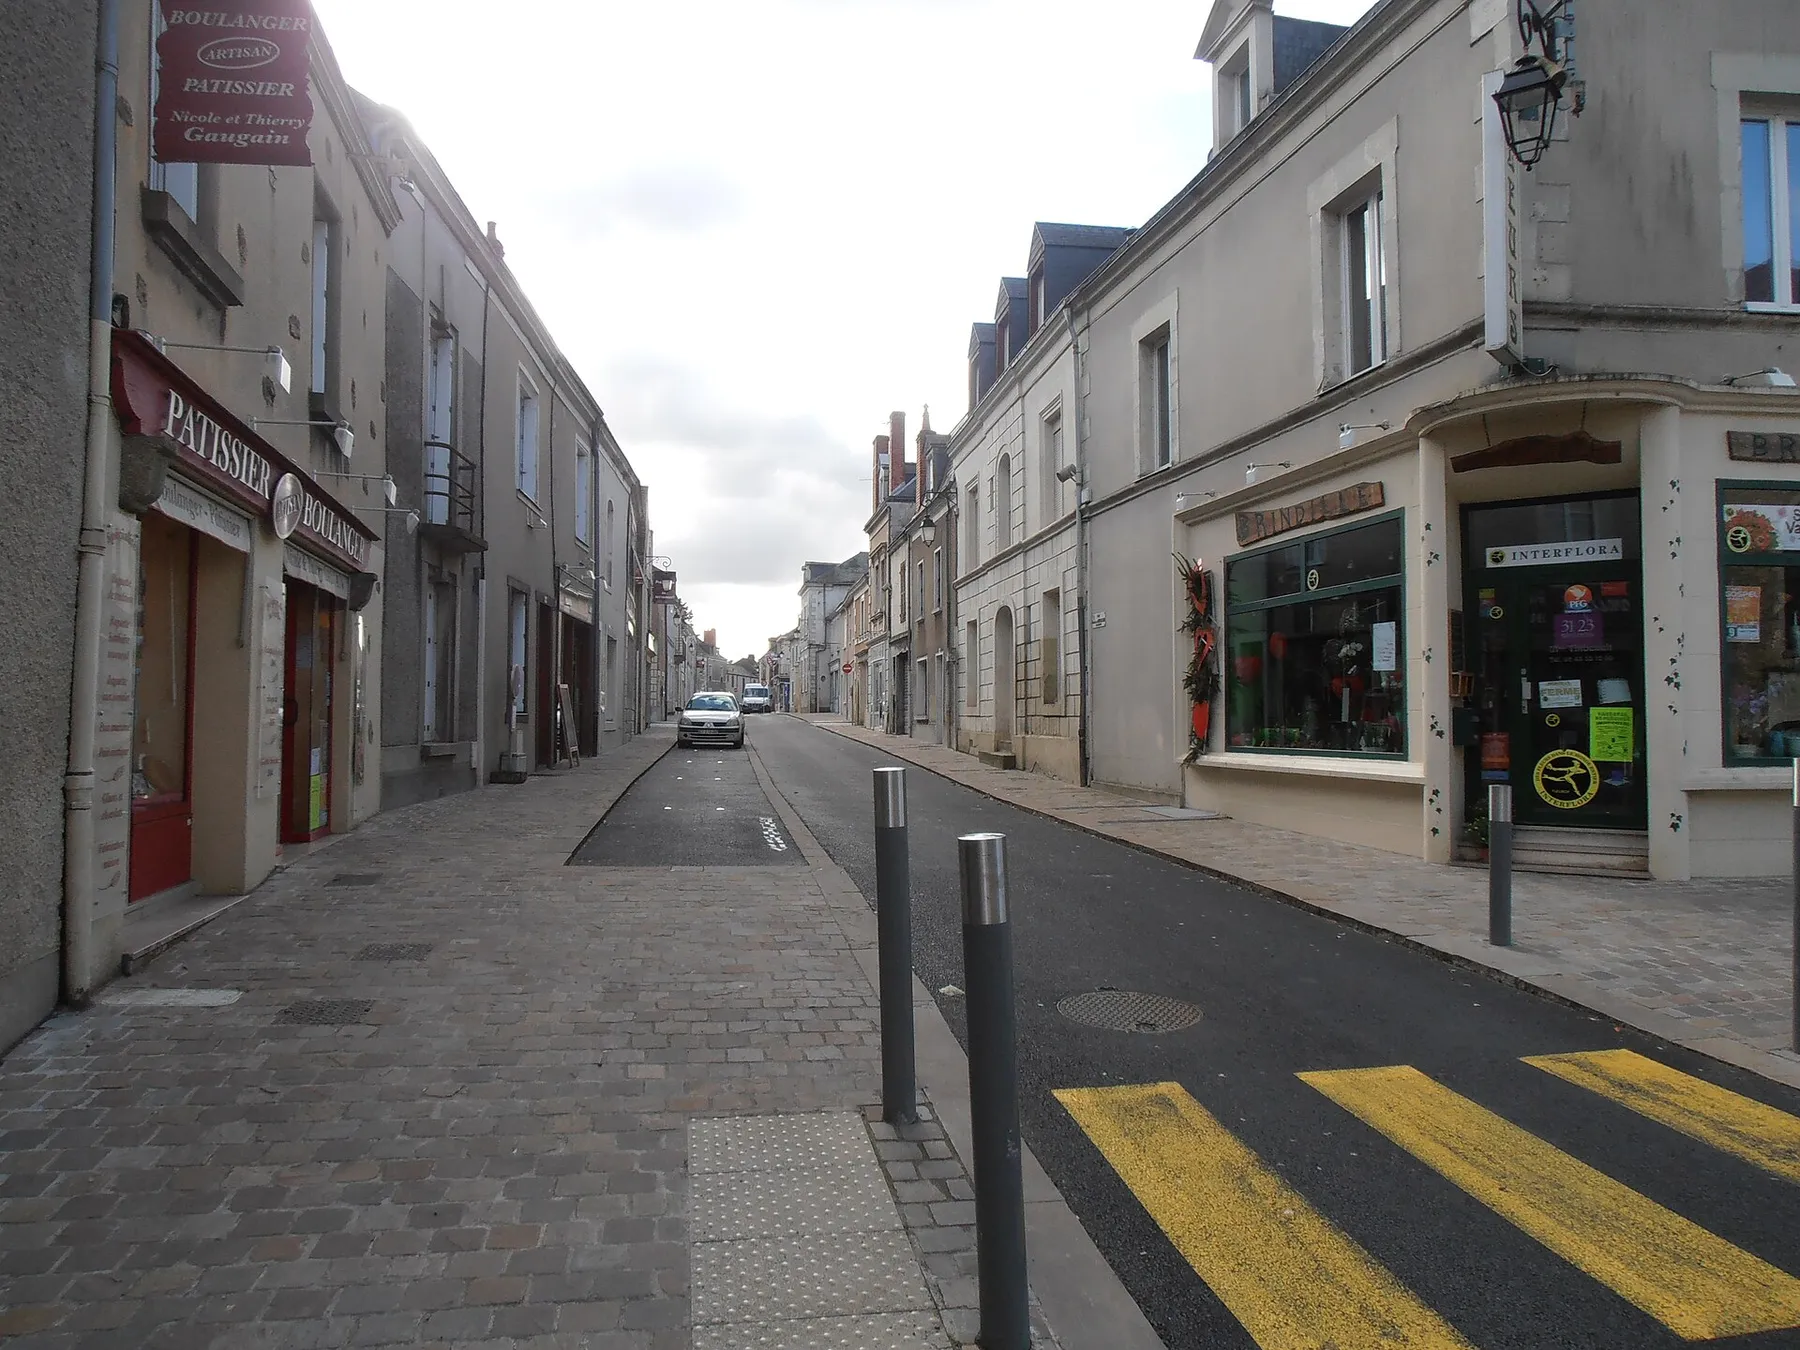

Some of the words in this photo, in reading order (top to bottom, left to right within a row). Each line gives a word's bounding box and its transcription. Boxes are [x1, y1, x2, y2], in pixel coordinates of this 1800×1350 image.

[169, 10, 309, 32] BOULANGER
[205, 46, 273, 61] ARTISAN
[182, 78, 295, 97] PATISSIER
[170, 110, 221, 124] Nicole
[224, 113, 242, 126] et
[245, 113, 306, 130] Thierry
[184, 127, 290, 147] Gaugain
[1507, 148, 1518, 345] LEURS
[163, 388, 271, 500] PATISSIER
[301, 492, 365, 564] BOULANGER
[1511, 544, 1621, 562] INTERFLORA
[1569, 600, 1588, 609] PFG
